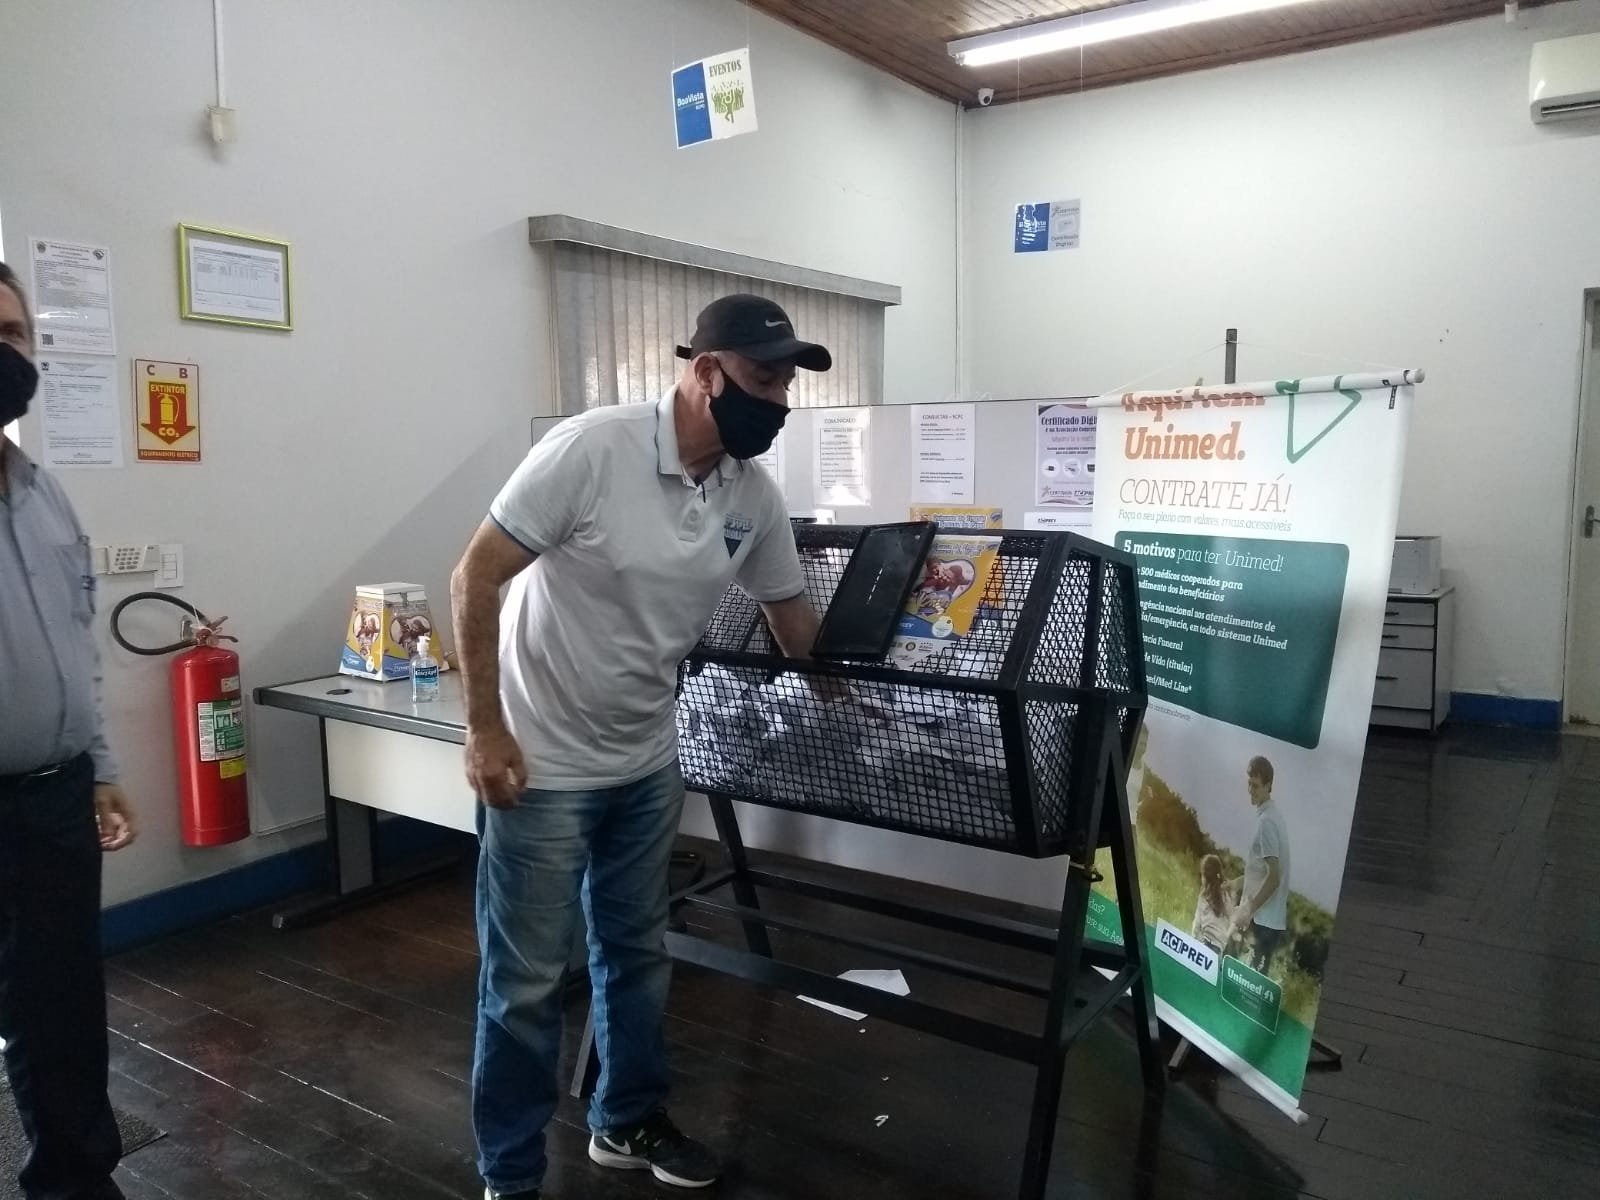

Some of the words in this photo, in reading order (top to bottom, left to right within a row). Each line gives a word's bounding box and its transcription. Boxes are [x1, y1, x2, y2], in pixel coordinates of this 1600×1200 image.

[709, 60, 742, 77] EVENTOS
[147, 365, 155, 376] C
[180, 368, 188, 378] B
[151, 384, 185, 394] EXTINTOR
[1041, 416, 1080, 425] Certificado
[1081, 415, 1097, 426] Digi
[1124, 421, 1246, 460] Unimed.
[1120, 478, 1248, 510] CONTRATE
[1250, 472, 1292, 514] JÁ!
[1118, 508, 1136, 521] Faça
[1142, 512, 1155, 521] seu
[1156, 512, 1176, 524] plano
[1176, 514, 1192, 524] com
[1193, 514, 1219, 526] valores
[1221, 518, 1244, 528] mais
[1124, 540, 1132, 552] 5
[1132, 541, 1176, 559] motivos
[1176, 548, 1202, 564] para
[1204, 549, 1222, 564] ter
[1225, 550, 1284, 572] Unimed!
[1154, 568, 1180, 580] médicos
[1181, 575, 1220, 586] cooperados
[1221, 580, 1243, 590] para
[1138, 580, 1167, 592] ndimento
[1167, 584, 1178, 594] dos
[1179, 586, 1225, 602] beneficiários
[1165, 605, 1194, 617] nacional
[1194, 610, 1205, 619] nos
[1205, 612, 1264, 630] atendimentos
[1264, 620, 1276, 632] de
[1141, 612, 1189, 632] ia/emergência,
[1190, 624, 1199, 632] em
[1200, 625, 1216, 636] todo
[1216, 628, 1252, 642] sistema
[1253, 634, 1288, 650] Unimed
[1157, 636, 1184, 650] Funeral
[1152, 654, 1166, 666] Vida
[1166, 657, 1193, 676] (titular)
[1160, 928, 1213, 971] ACIPREV
[1227, 967, 1262, 996] Unimed
